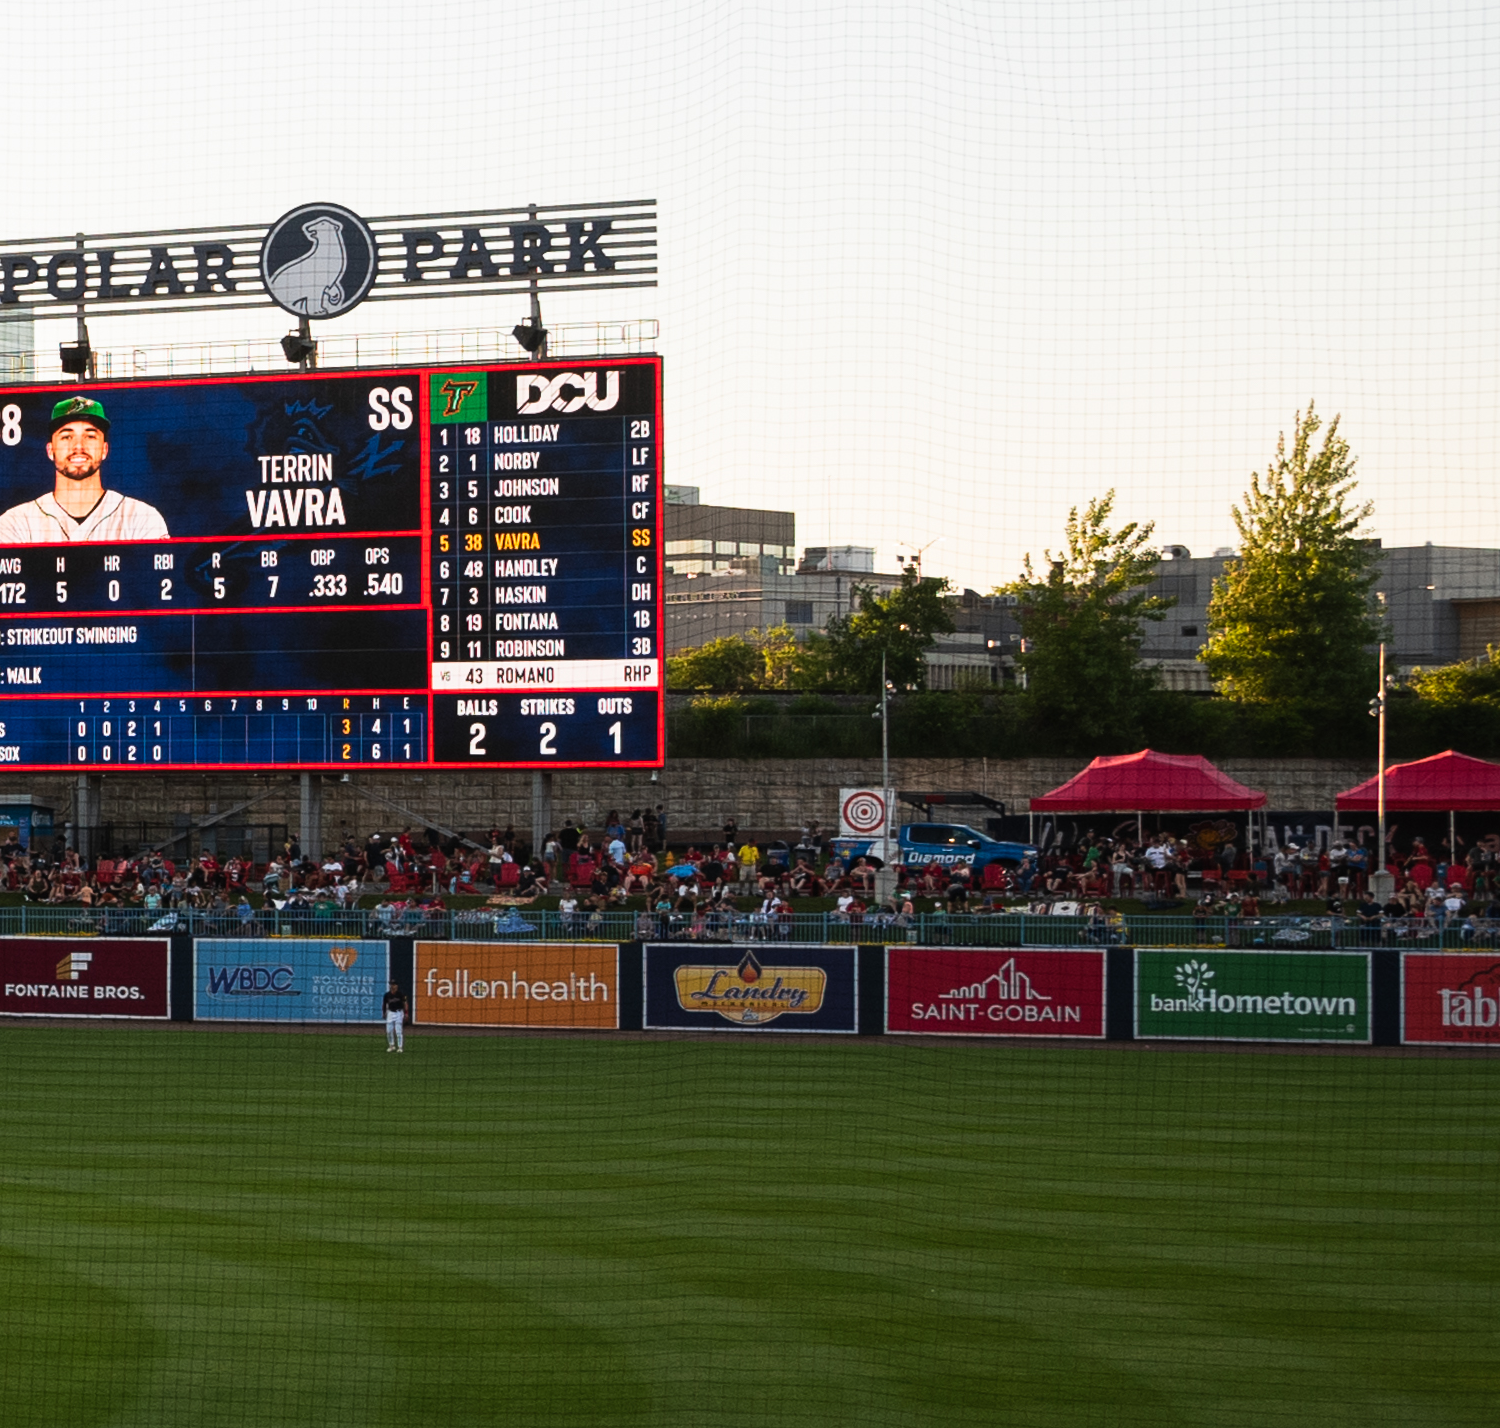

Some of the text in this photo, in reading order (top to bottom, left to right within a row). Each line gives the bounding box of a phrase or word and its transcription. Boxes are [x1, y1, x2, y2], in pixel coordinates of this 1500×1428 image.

[0, 220, 617, 304] POLAR PARK
[517, 371, 619, 414] DCU
[369, 386, 413, 430] SS
[441, 421, 650, 445] 1 18 HOLLIDAY 2B
[258, 454, 332, 483] TERRIN
[439, 448, 649, 472] 2 1 NORBY LF
[440, 474, 649, 499] 3 5 JOHNSON RF
[246, 488, 346, 527] VAVRA
[439, 502, 650, 525] 4 6 COOK CF
[440, 529, 650, 552] 5 38 VAVRA SS
[0, 548, 389, 574] AVG H HR RBI R BB OBP OPS
[440, 556, 646, 579] 6 48 HANDLEY C
[57, 582, 67, 603] 5
[109, 580, 119, 601] 0
[161, 579, 172, 600] 2
[214, 577, 225, 599] 5
[268, 576, 278, 597] 7
[309, 574, 347, 596] .333
[363, 573, 402, 595] .540
[441, 583, 651, 605] 7 3 HASKIN DH
[441, 610, 650, 631] 8 19 FONTANA 1B
[7, 628, 74, 645] STRIKEOUT
[77, 626, 137, 644] SWINGING
[441, 638, 651, 658] 9 11 ROBINSON 3B
[7, 667, 41, 684] WALK
[466, 665, 651, 684] 43 ROMANO RHP
[457, 698, 632, 716] BALLS STRIKES OUTS
[470, 722, 621, 754] 2 2 1
[908, 852, 975, 865] Diamond
[208, 966, 294, 993] WBDC
[312, 975, 376, 986] WORCESTER
[312, 985, 375, 996] REGIONAL
[424, 968, 609, 1002] fallonhealth
[691, 970, 810, 1008] Landry
[5, 984, 146, 1000] FONTAINE BROS.
[312, 996, 375, 1006] CHAMBER OF
[312, 1006, 375, 1017] COMMERCE
[911, 1002, 1082, 1023] SAINT-GOBAIN
[1437, 986, 1500, 1028] Tab
